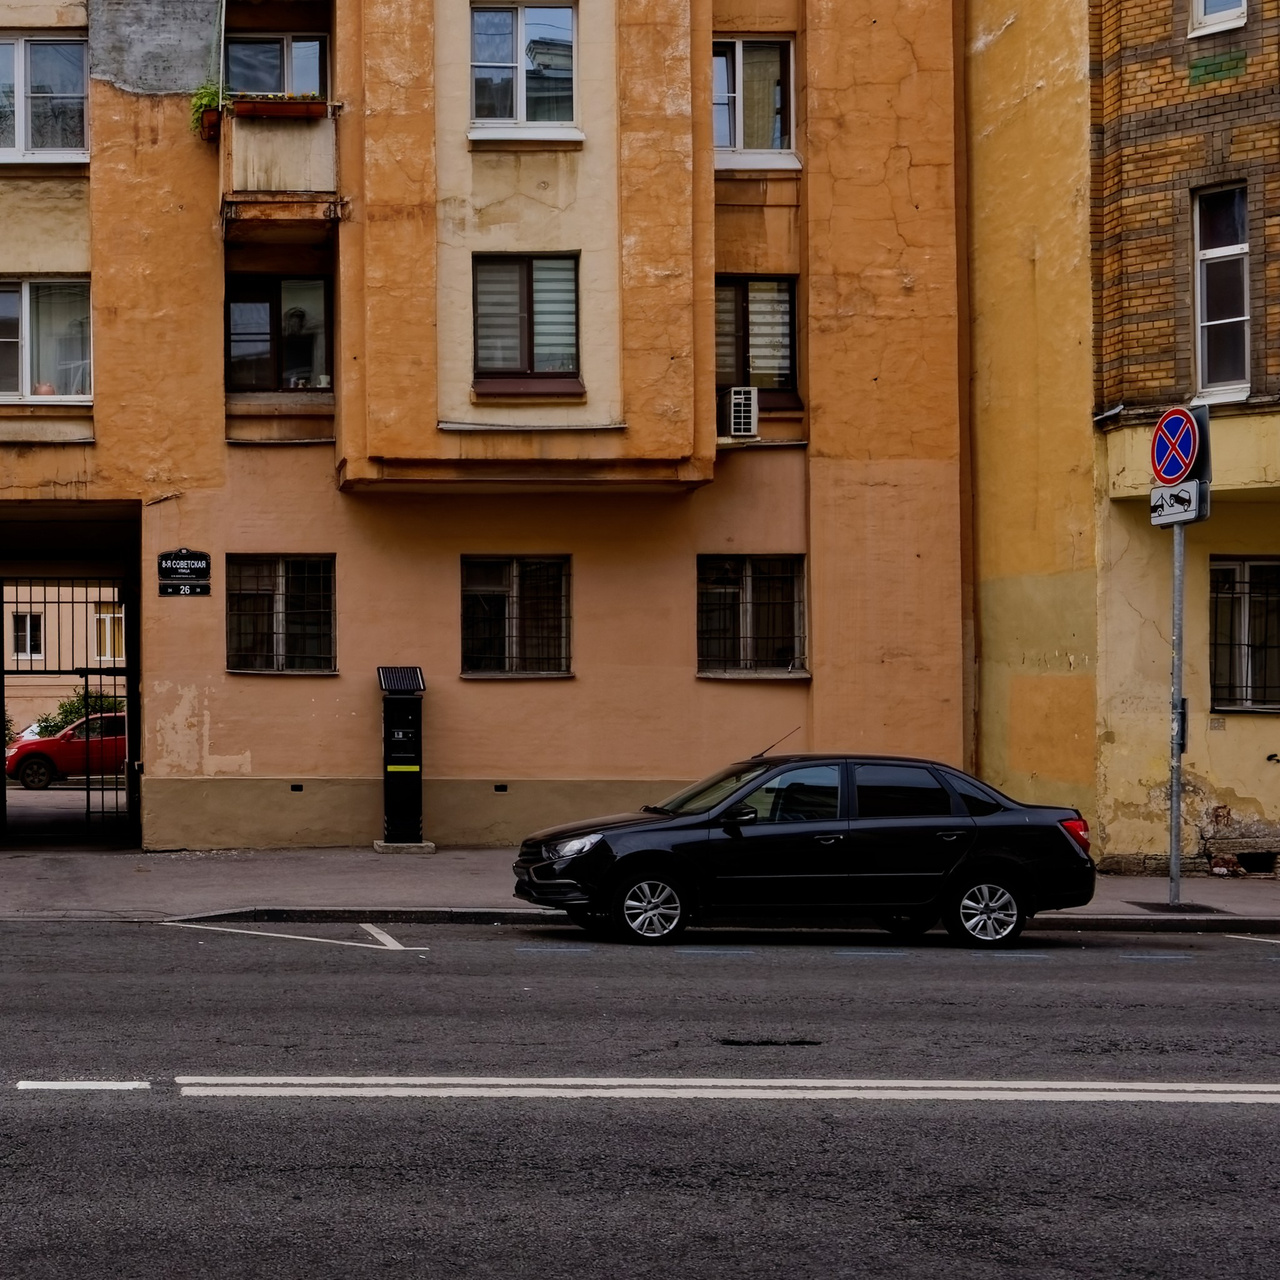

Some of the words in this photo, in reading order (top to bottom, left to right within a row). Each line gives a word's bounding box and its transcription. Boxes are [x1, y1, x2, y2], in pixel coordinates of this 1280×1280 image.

[161, 560, 172, 569] 8-Я
[172, 560, 207, 569] СОВЕТСКАЯ
[179, 585, 191, 595] 26
